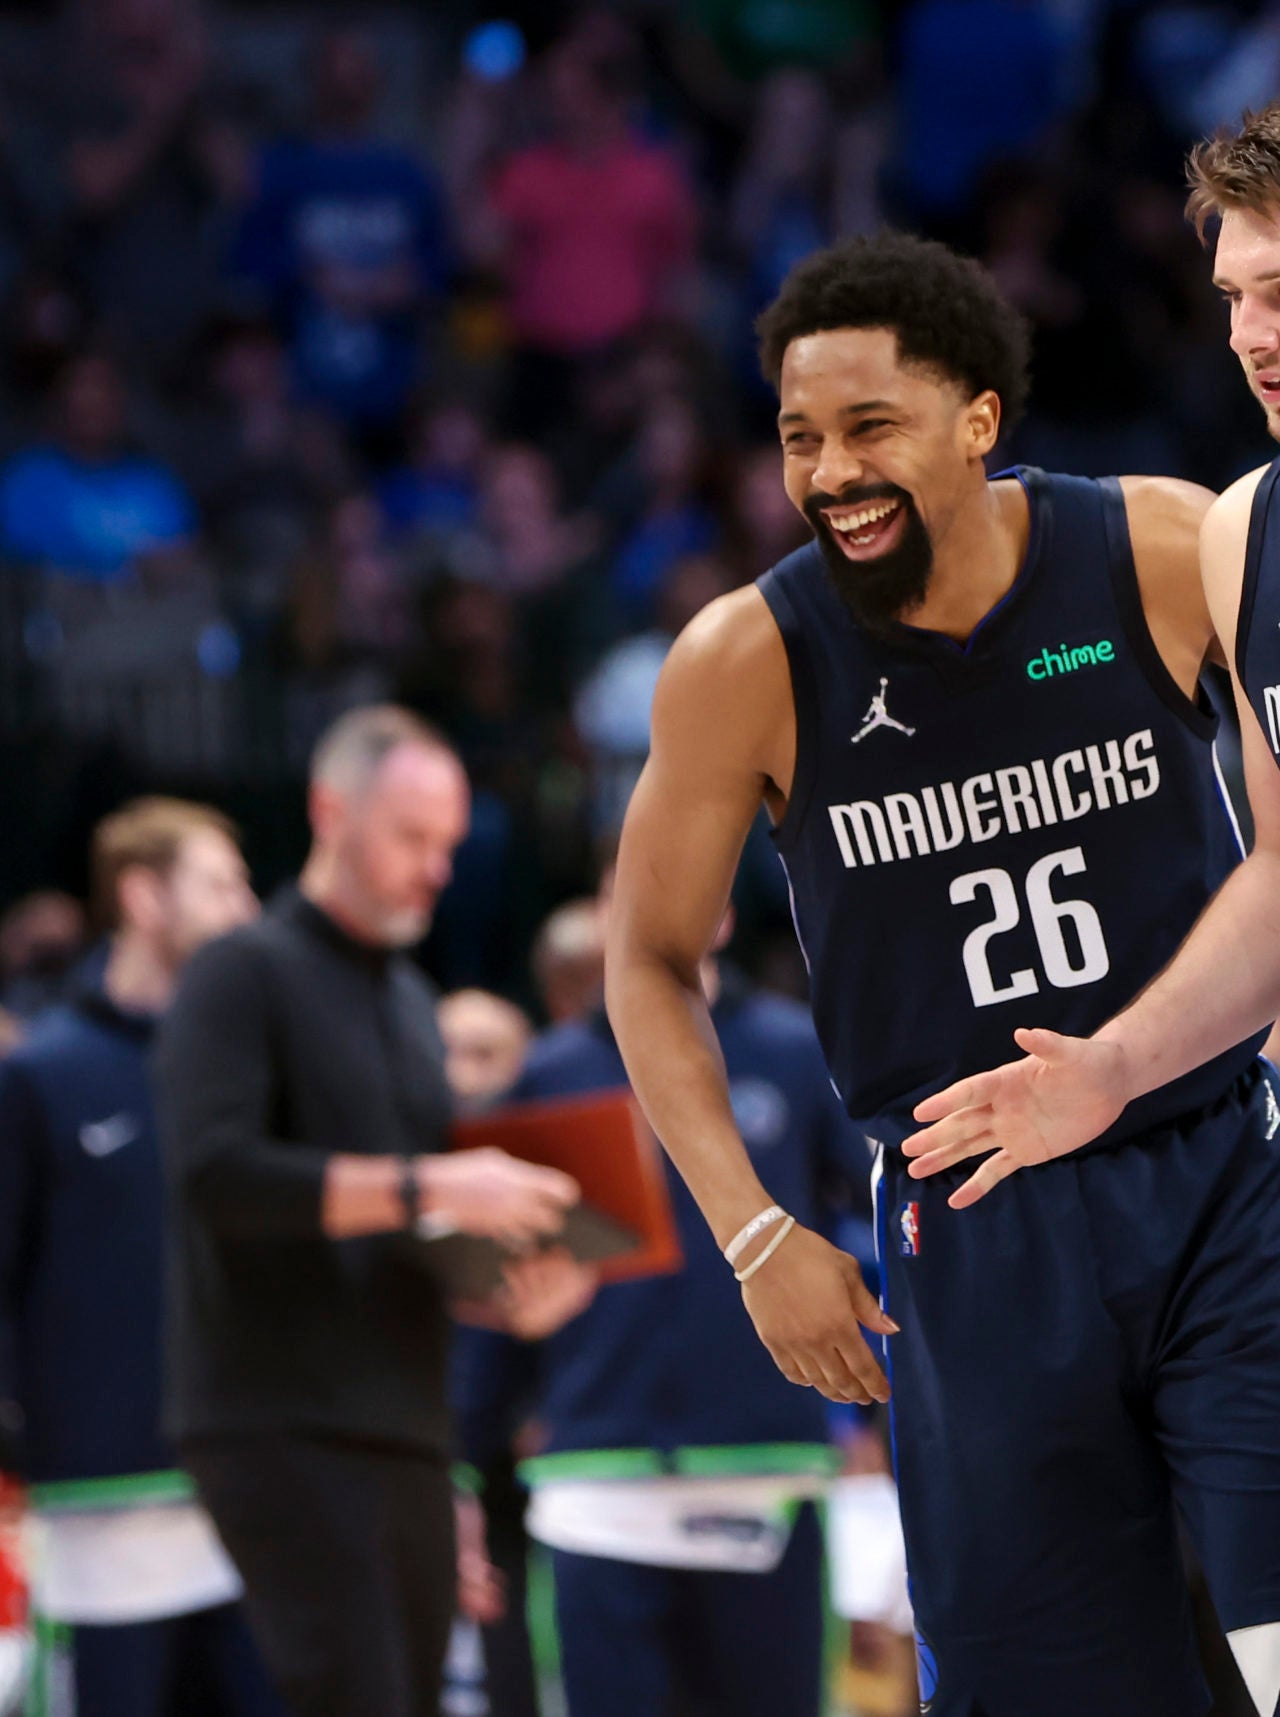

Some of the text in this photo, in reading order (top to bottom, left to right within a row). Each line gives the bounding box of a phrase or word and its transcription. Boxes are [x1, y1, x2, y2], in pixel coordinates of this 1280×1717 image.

[1027, 640, 1115, 680] chime
[828, 729, 1160, 868] MAVERICKS
[949, 847, 1110, 1008] 26
